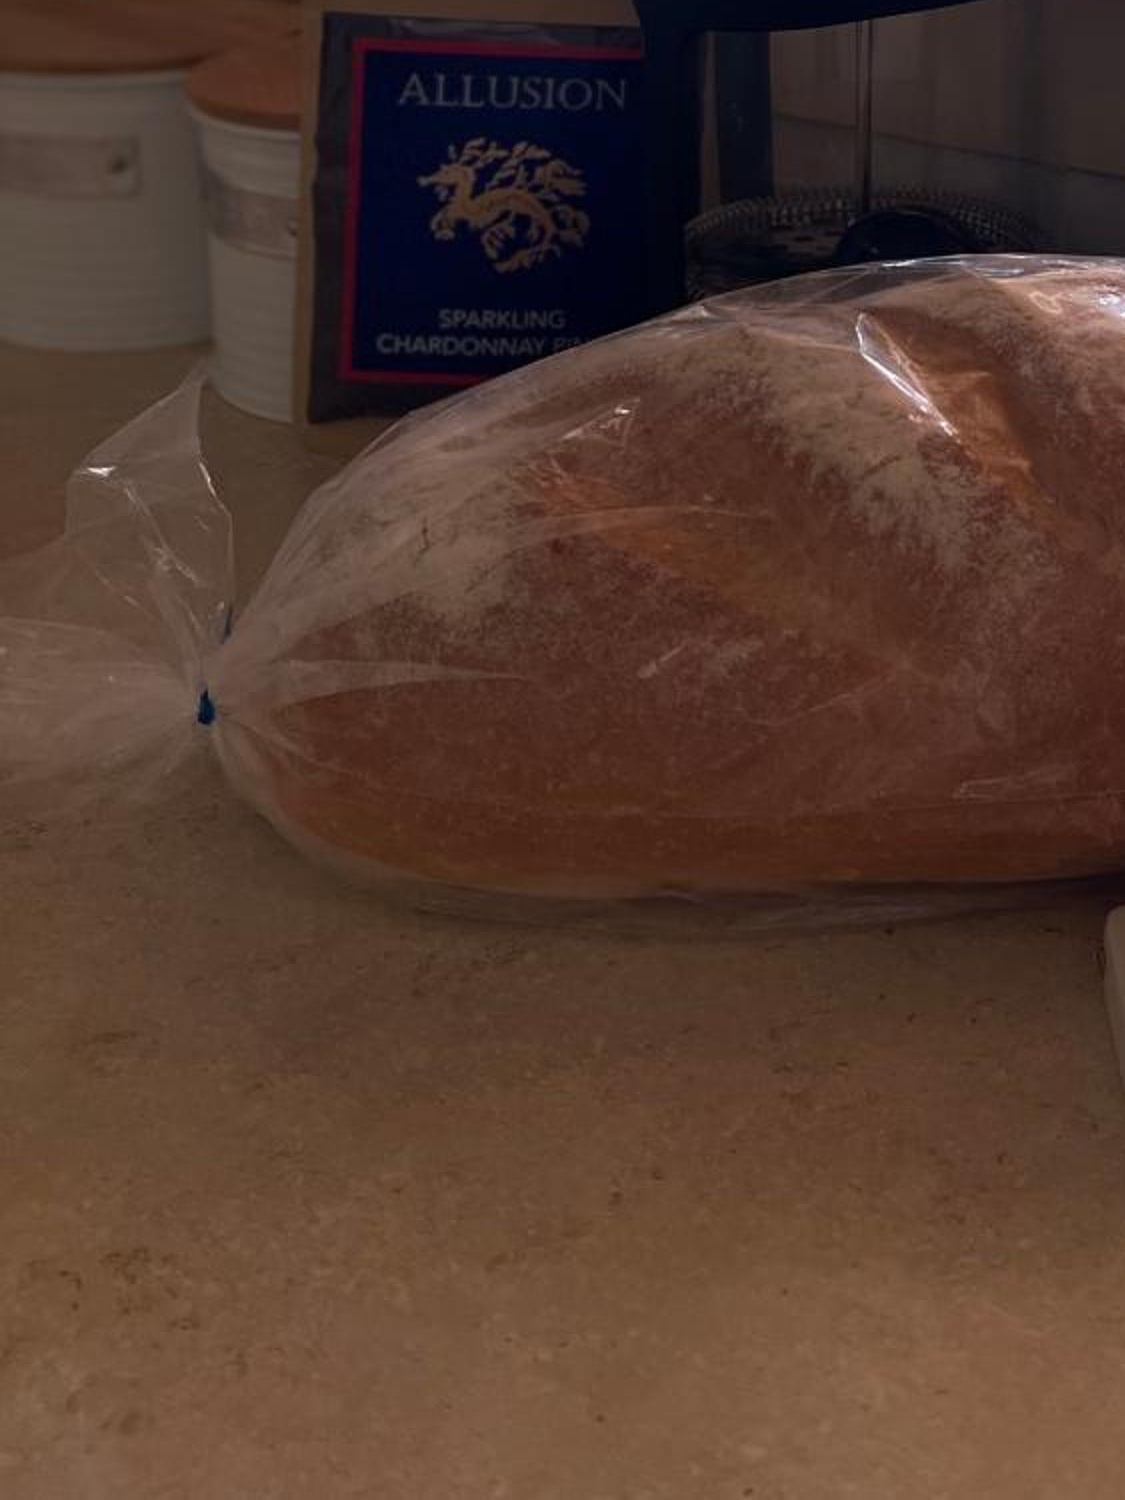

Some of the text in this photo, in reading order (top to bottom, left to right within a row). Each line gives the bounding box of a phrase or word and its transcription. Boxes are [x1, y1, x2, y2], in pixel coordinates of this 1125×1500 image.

[397, 72, 627, 111] ALLUSION
[439, 308, 567, 330] SPARKLING
[375, 333, 545, 357] CHARDONNAY
